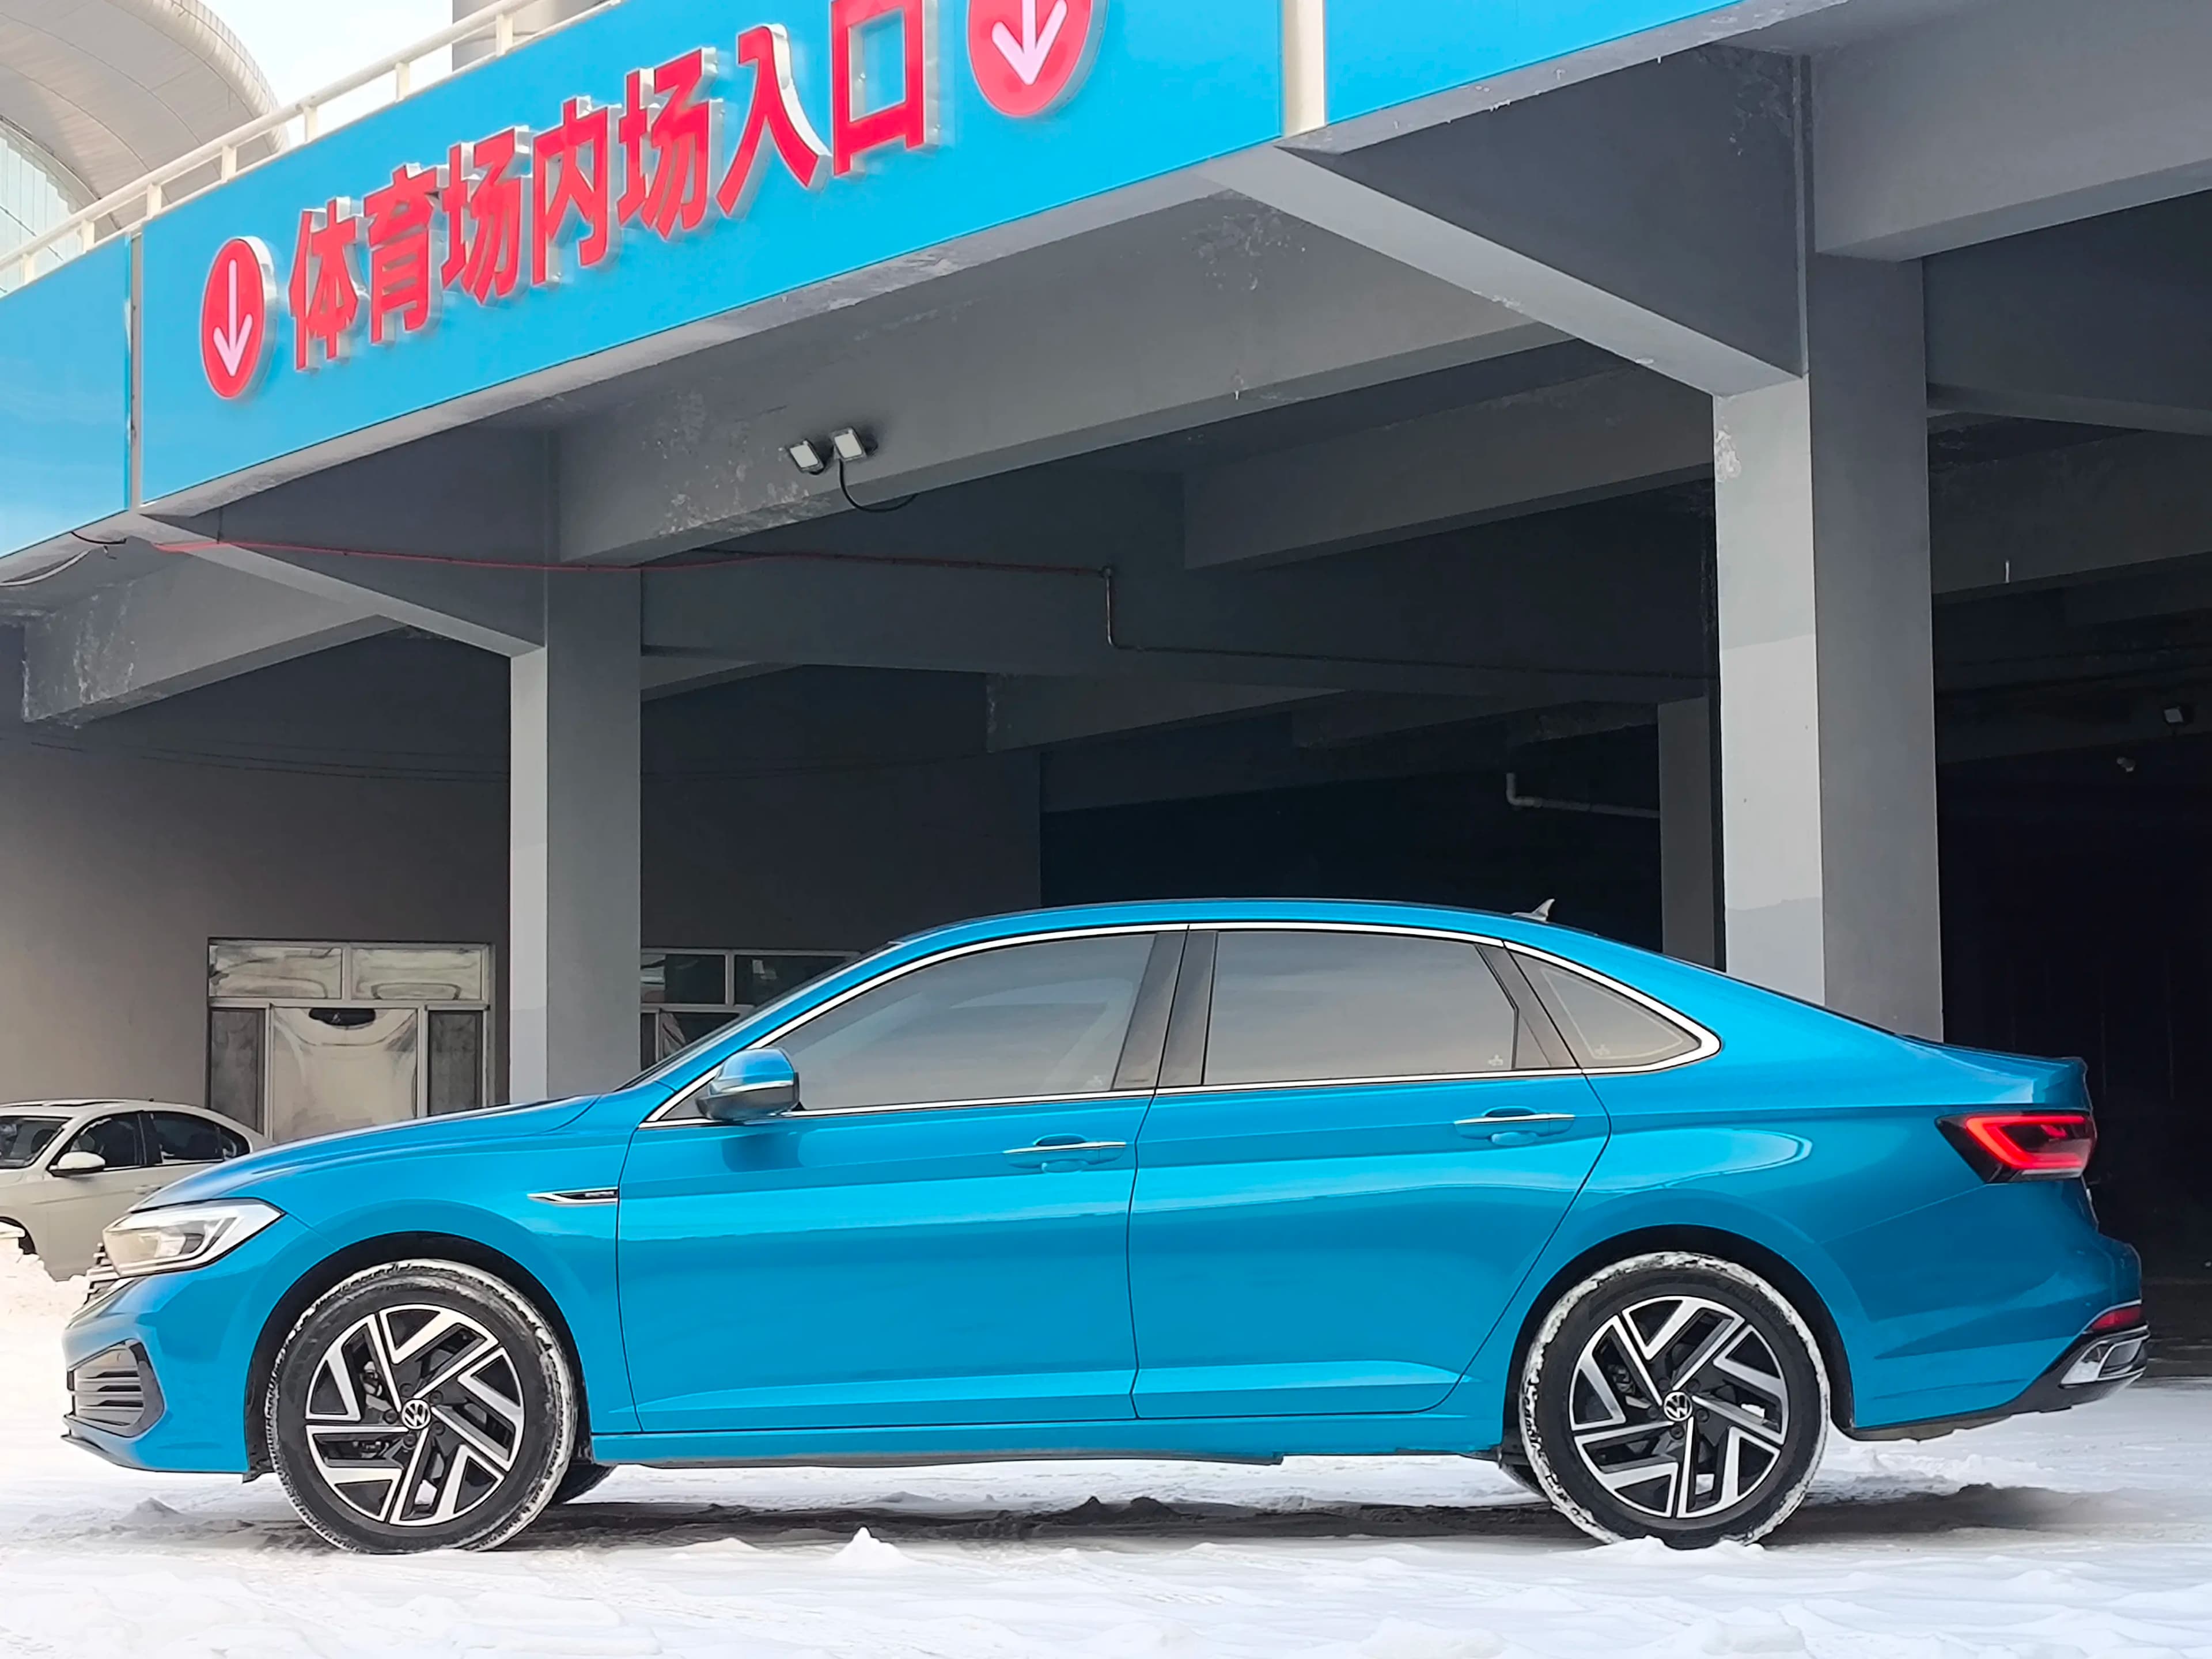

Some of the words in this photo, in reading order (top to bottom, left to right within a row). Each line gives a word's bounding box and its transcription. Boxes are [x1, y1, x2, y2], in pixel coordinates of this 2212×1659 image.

[287, 0, 925, 371] 体育场内场入口
[402, 1399, 431, 1429] VW
